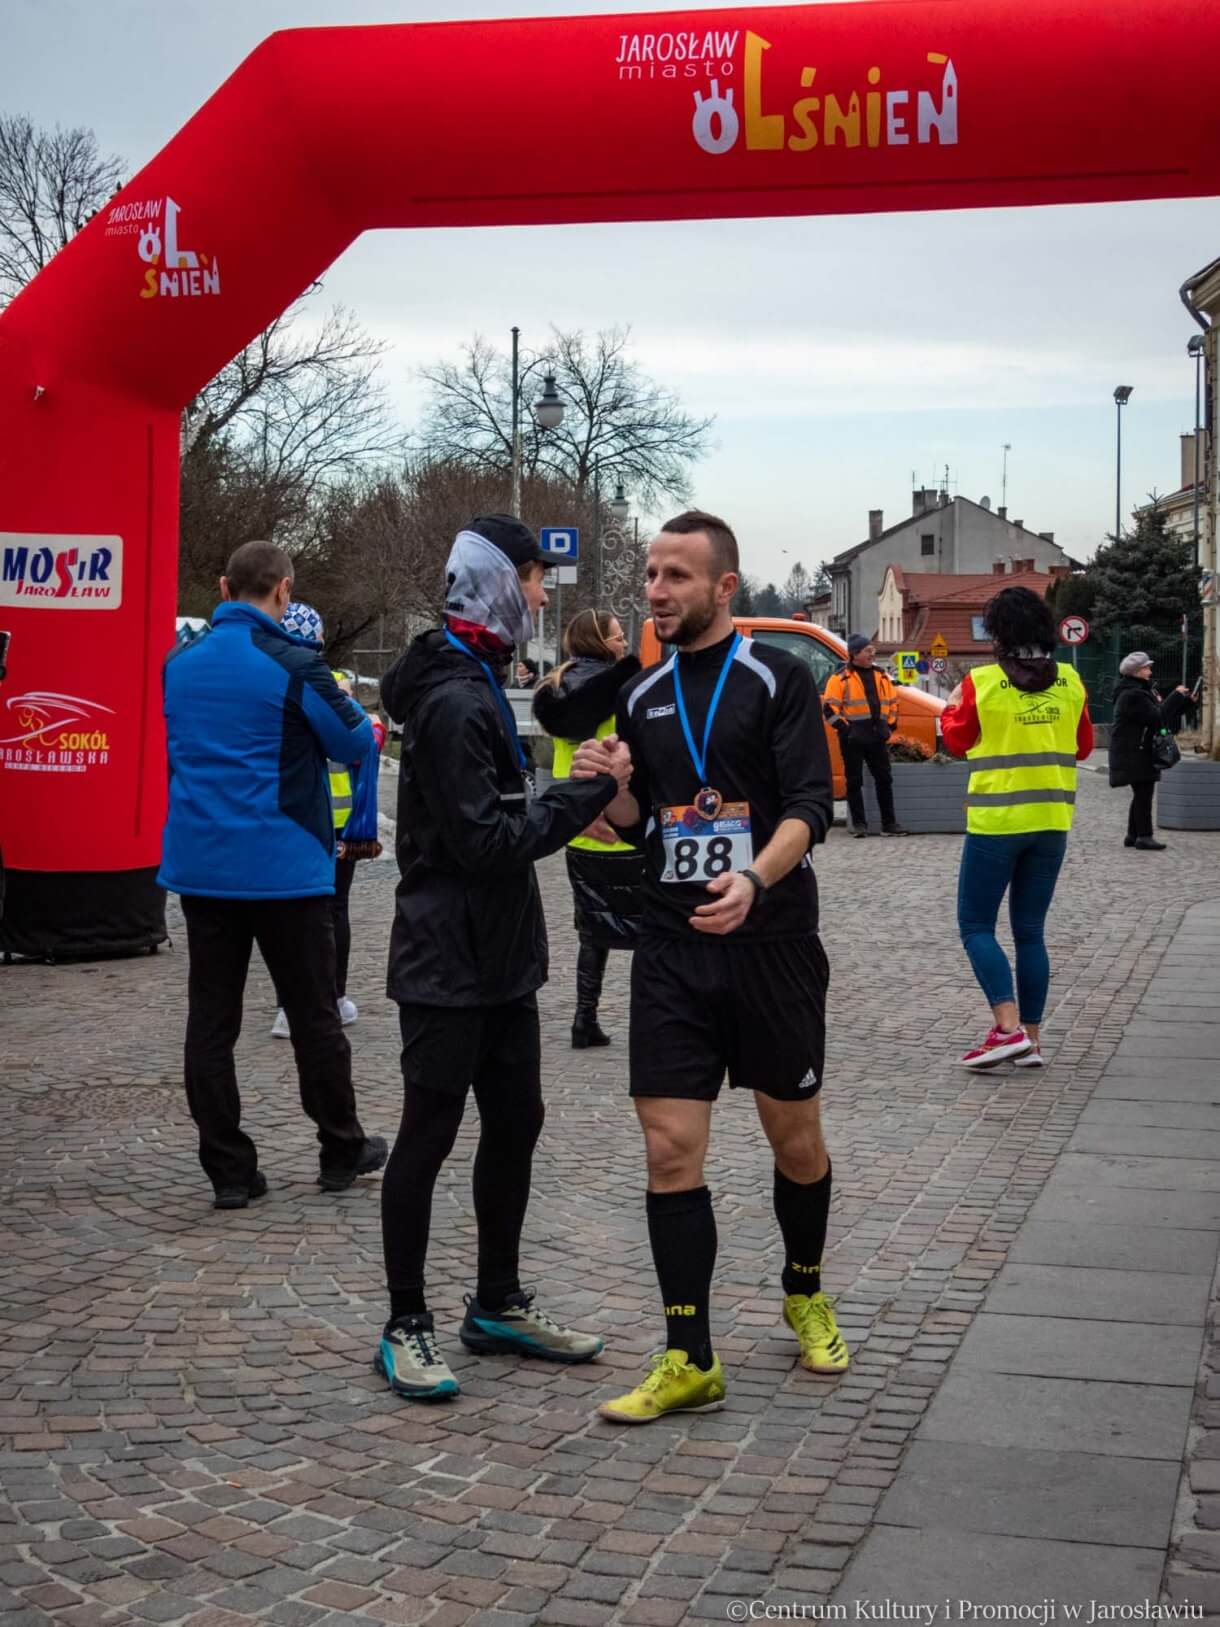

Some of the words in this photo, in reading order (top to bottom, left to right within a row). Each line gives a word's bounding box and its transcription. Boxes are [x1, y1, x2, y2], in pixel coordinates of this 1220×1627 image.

[616, 30, 738, 62] JAROSŁAW
[619, 61, 734, 79] miasto
[107, 198, 163, 225] JAROSŁAW
[104, 223, 139, 237] miasto
[934, 660, 945, 669] 20
[58, 729, 111, 750] SOKÓŁ
[674, 836, 733, 880] 88
